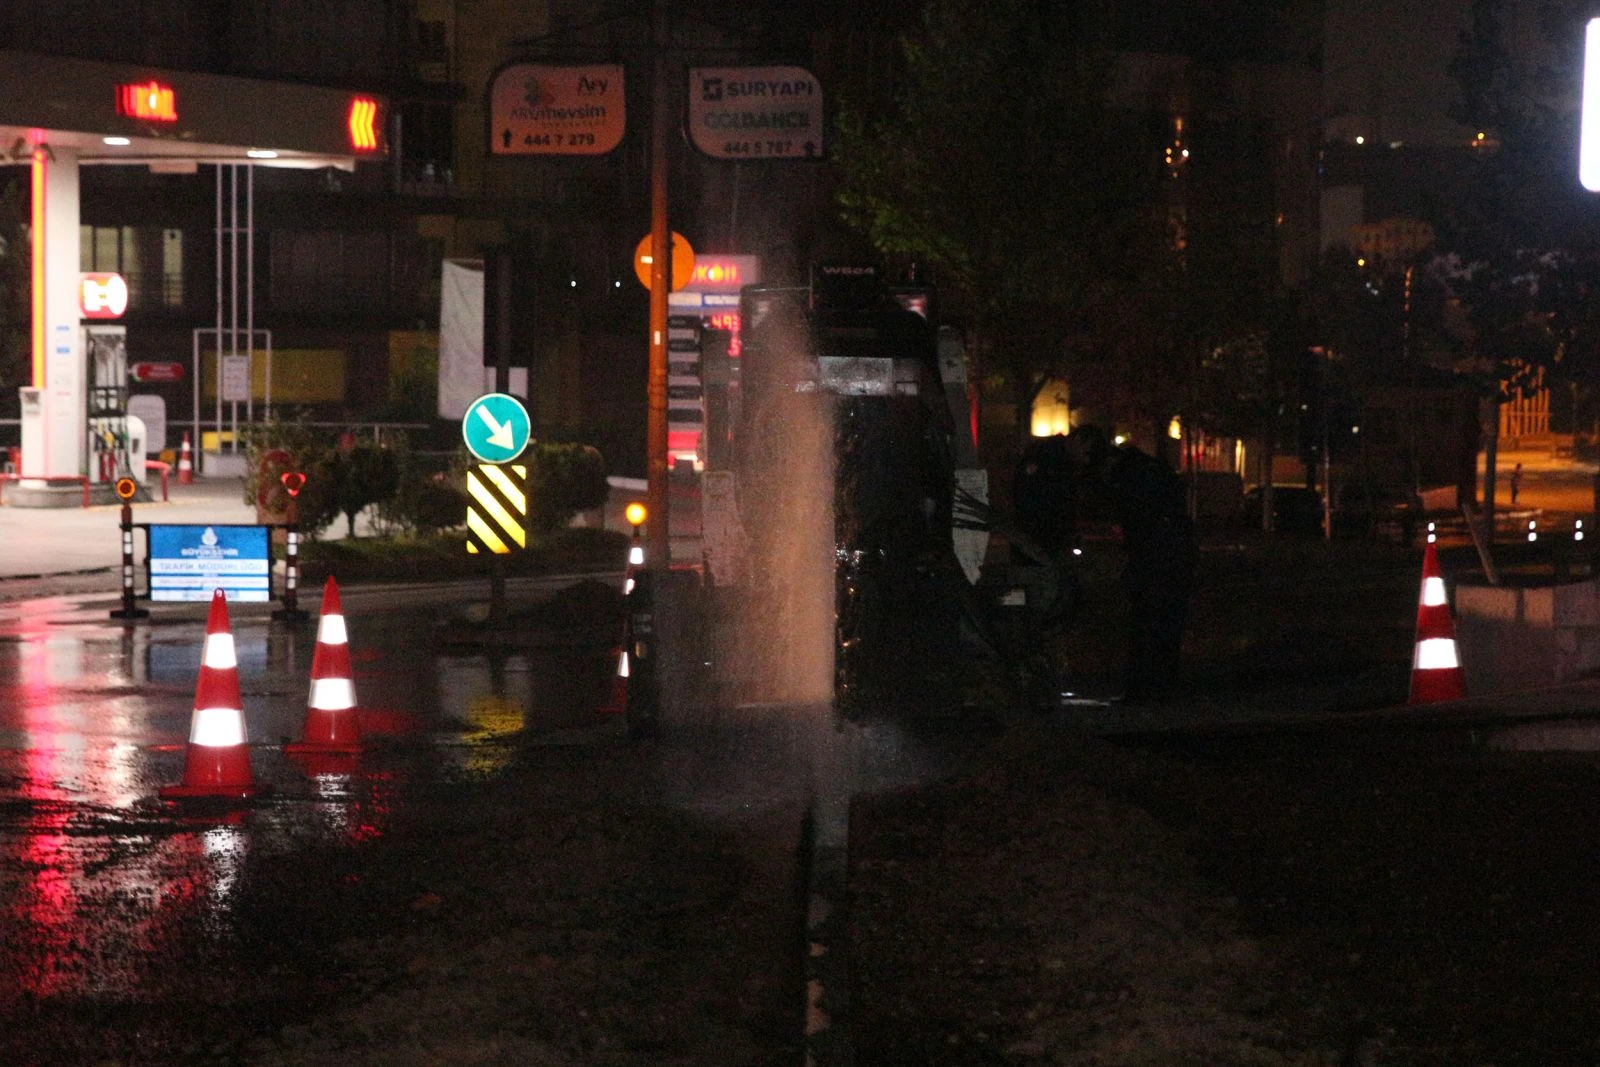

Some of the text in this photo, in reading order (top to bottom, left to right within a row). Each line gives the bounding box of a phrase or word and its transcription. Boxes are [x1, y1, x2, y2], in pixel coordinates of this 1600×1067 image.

[727, 81, 813, 97] SURYAPI
[524, 133, 596, 146] 444 7 279
[724, 141, 749, 154] 444
